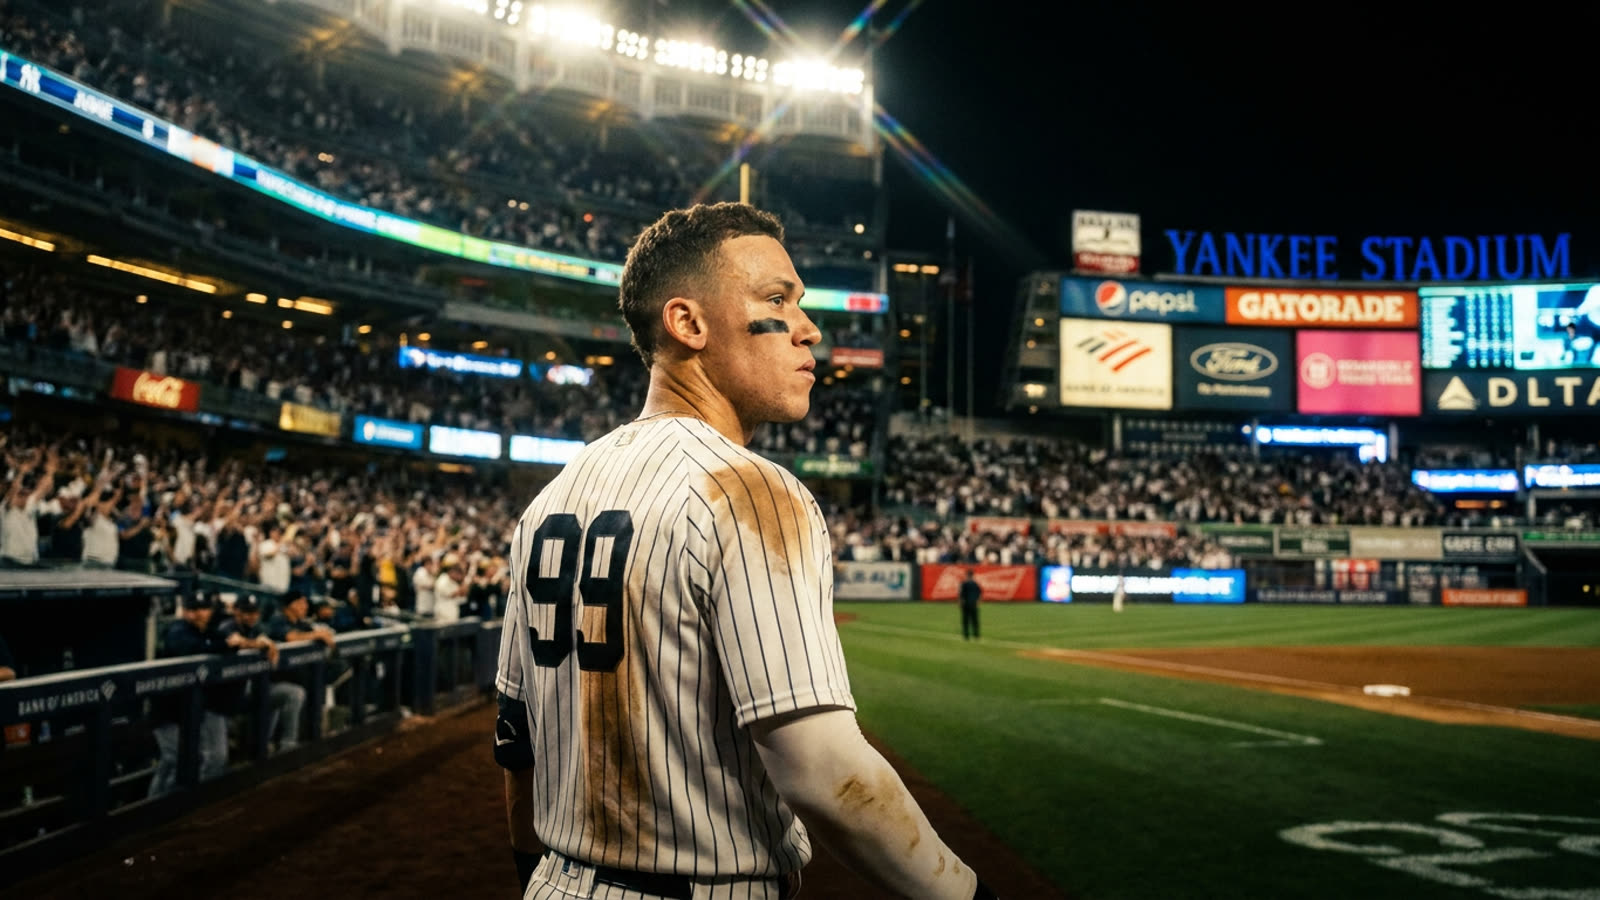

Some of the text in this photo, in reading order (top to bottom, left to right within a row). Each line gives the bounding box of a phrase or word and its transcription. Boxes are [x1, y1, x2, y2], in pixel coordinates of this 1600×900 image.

[1164, 229, 1571, 281] YANKEE STADIUM
[1129, 290, 1196, 316] pepsi
[1237, 292, 1404, 323] GATORADE
[1205, 347, 1262, 375] Ford
[525, 510, 633, 672] 99
[18, 698, 46, 716] BANK
